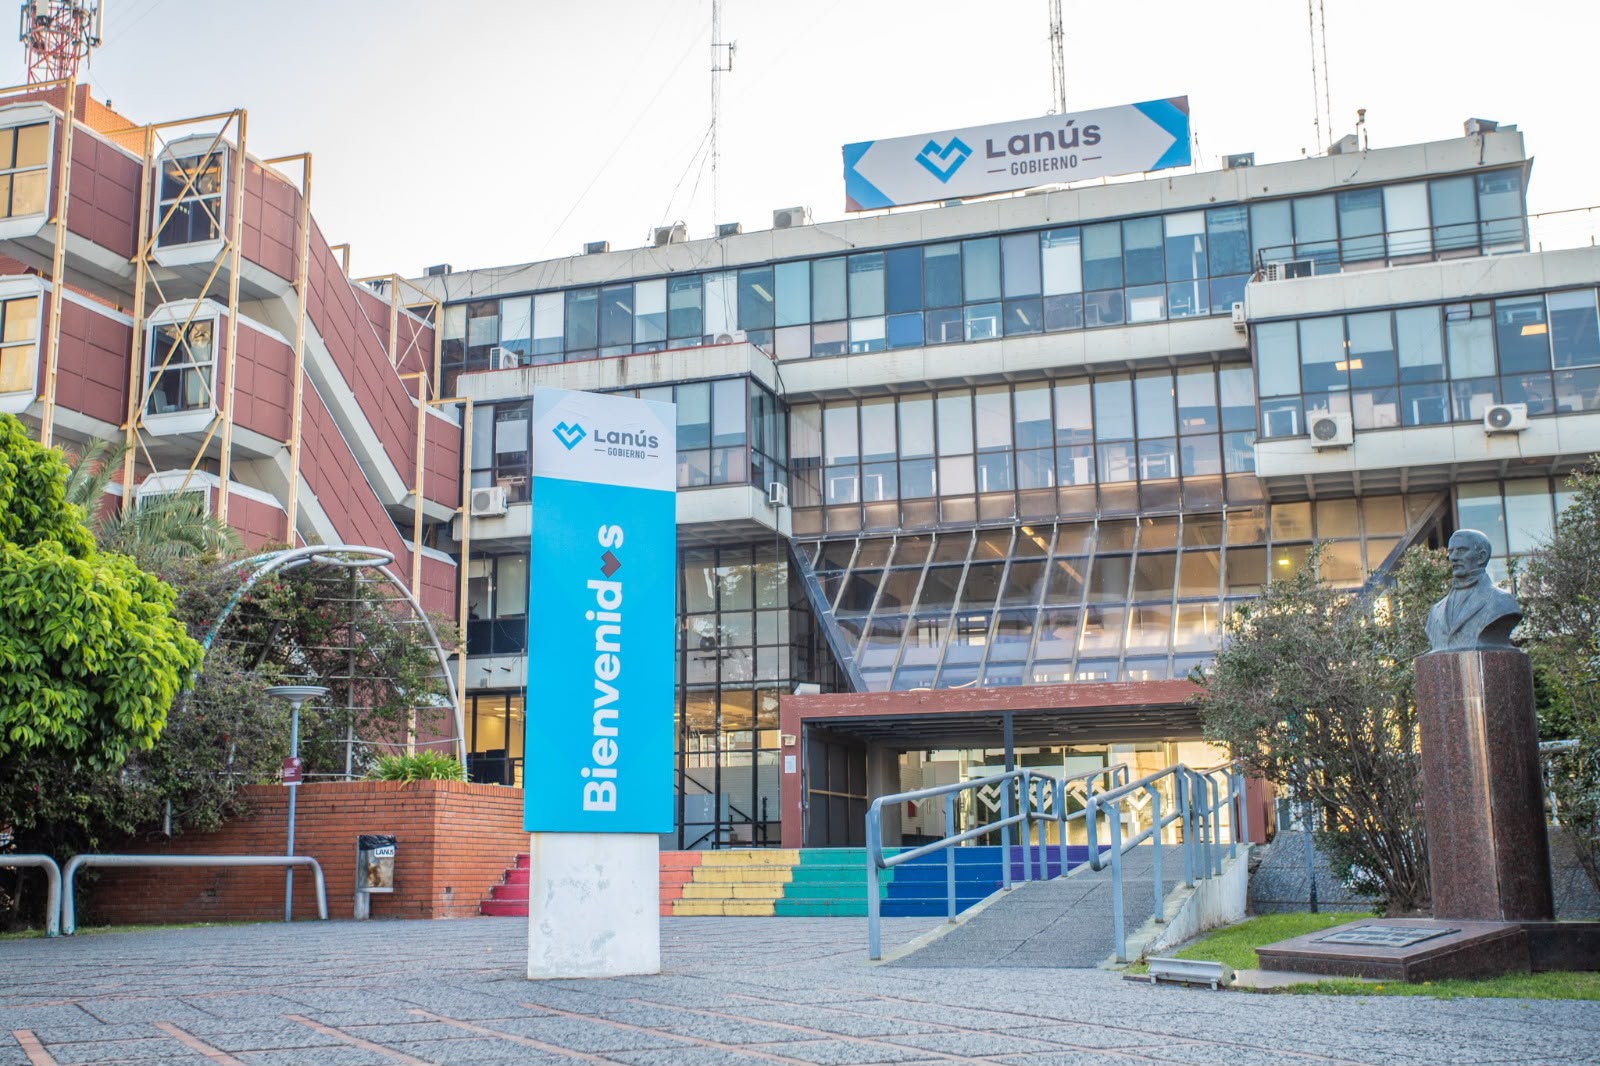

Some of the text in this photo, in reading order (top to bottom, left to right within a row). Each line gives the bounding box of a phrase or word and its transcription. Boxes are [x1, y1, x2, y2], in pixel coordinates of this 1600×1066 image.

[986, 120, 1101, 158] Lanús
[1011, 155, 1077, 175] GOBIERNO
[594, 429, 659, 449] Lanús
[607, 447, 646, 460] GOBIERNO
[580, 524, 624, 812] Bienvenids
